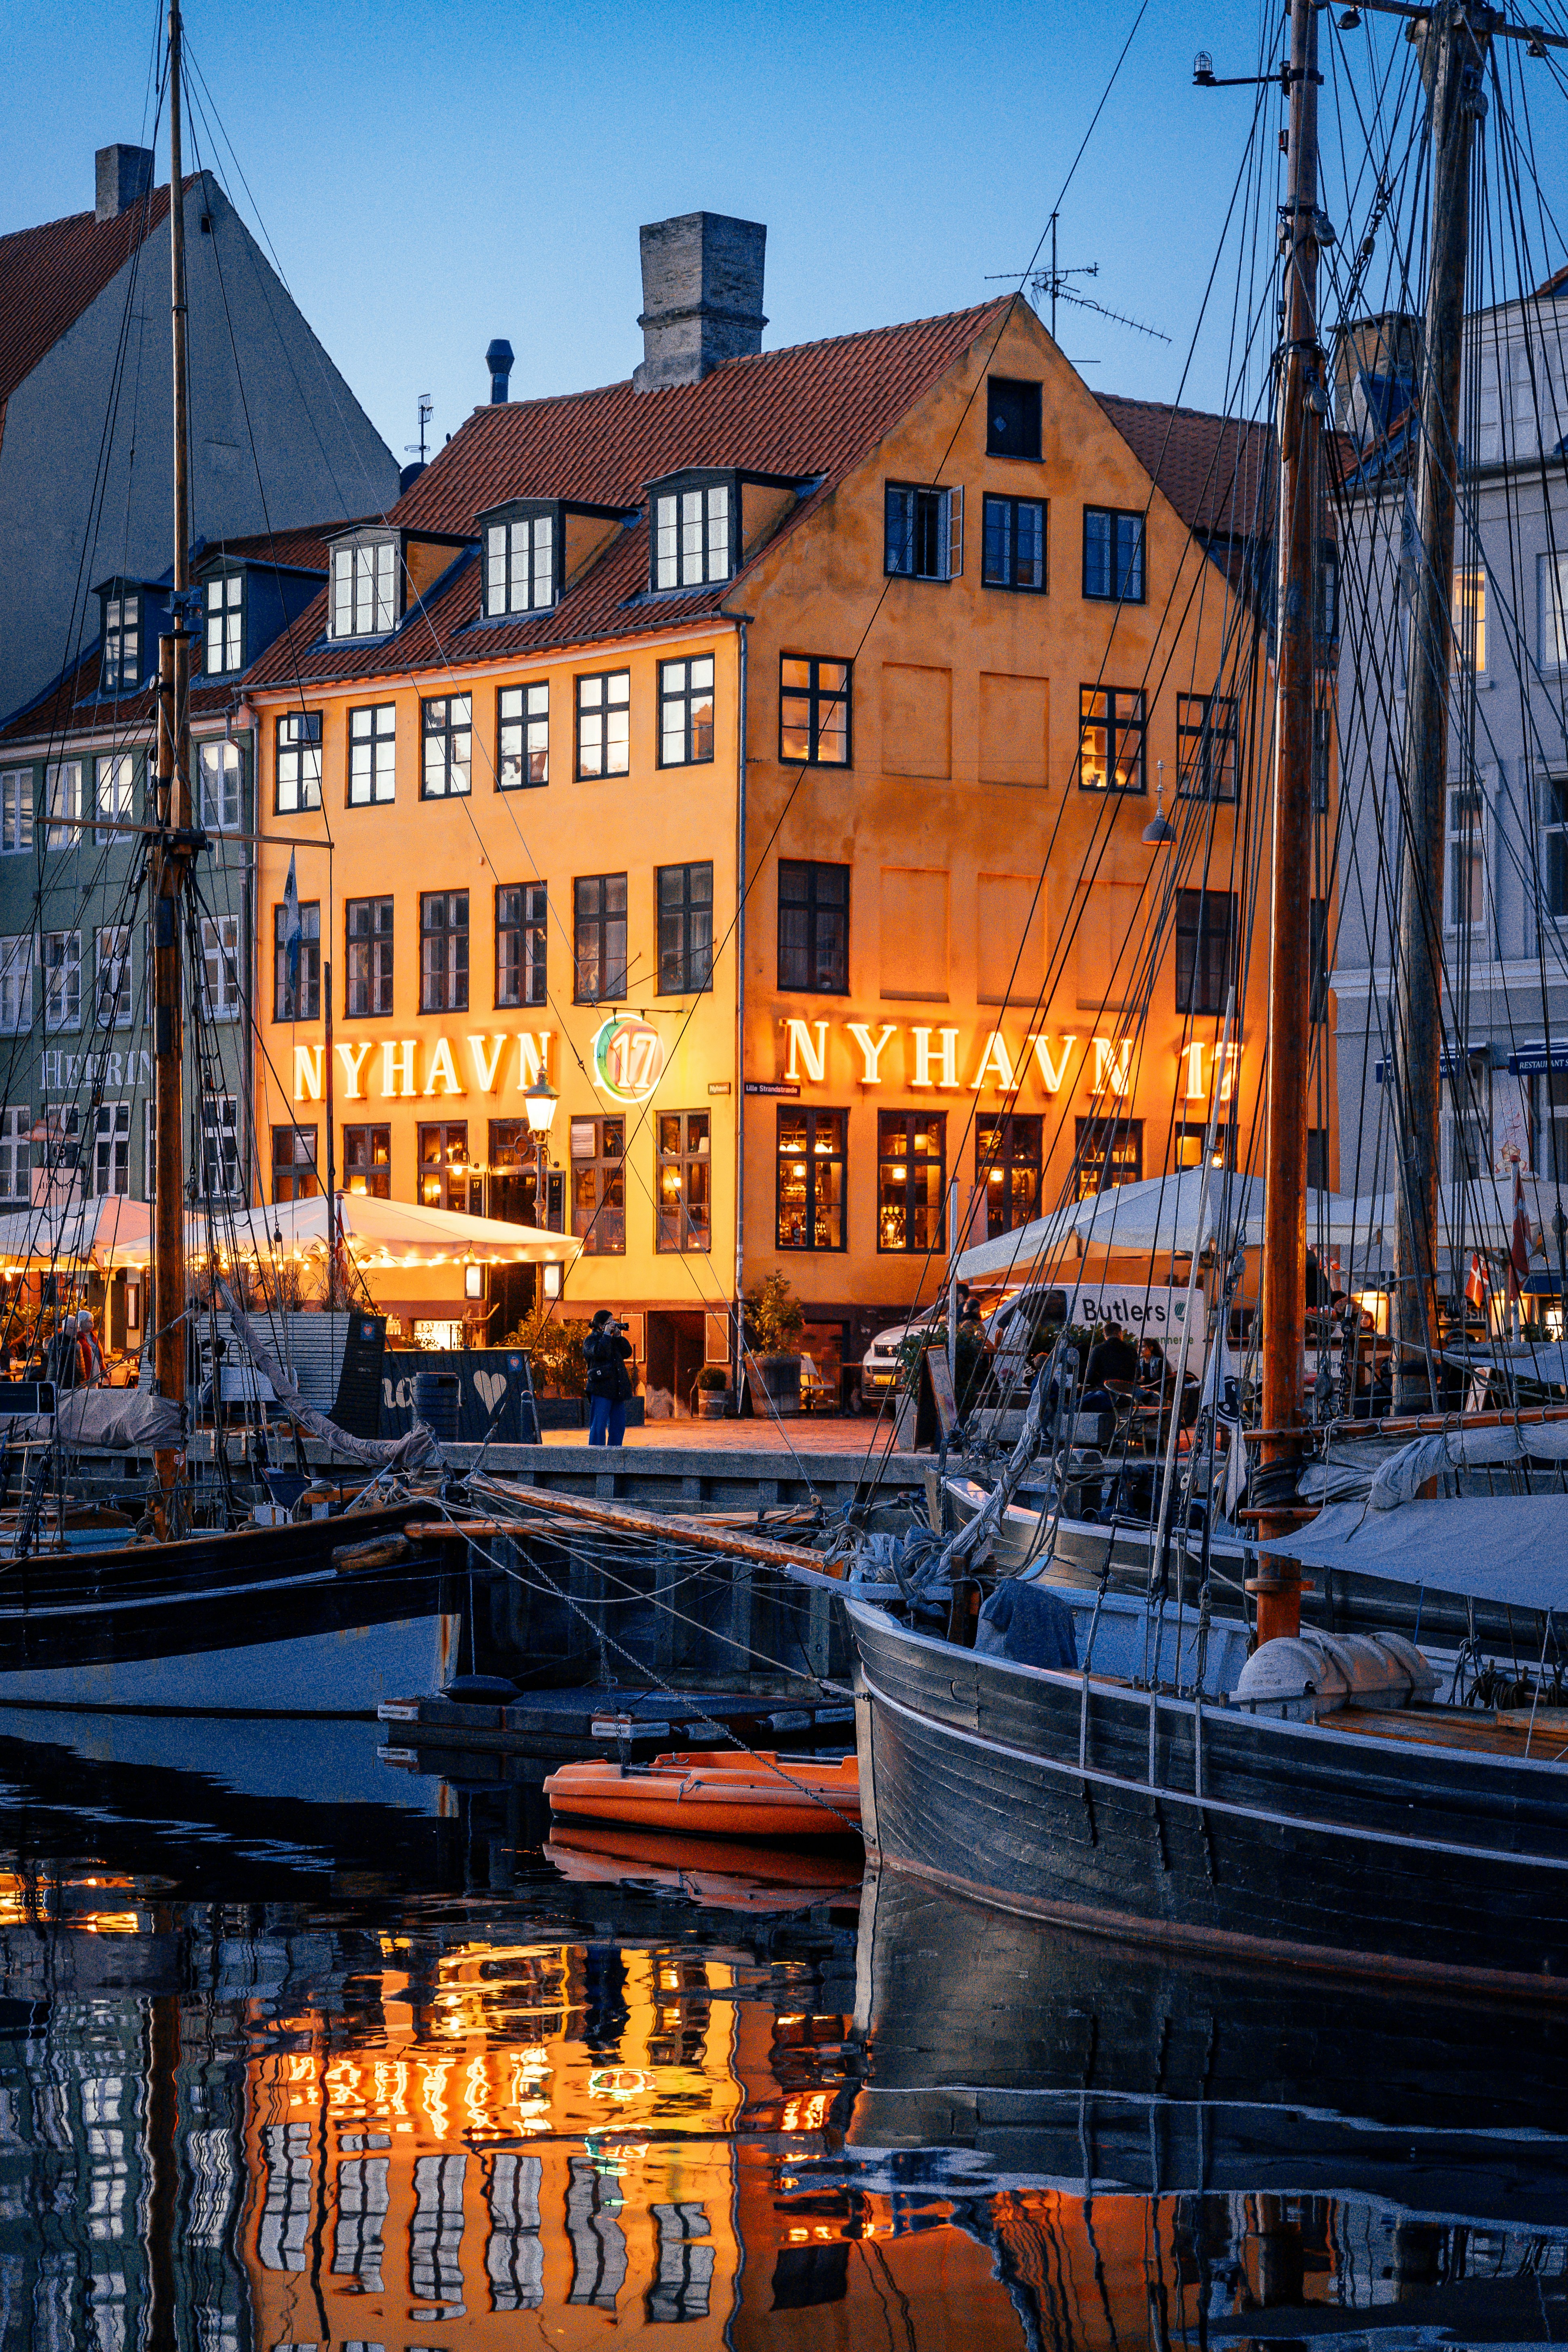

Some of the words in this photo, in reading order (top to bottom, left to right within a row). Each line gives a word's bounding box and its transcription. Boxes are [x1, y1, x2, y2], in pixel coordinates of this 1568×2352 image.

[39, 1050, 155, 1090] HERRIN
[293, 1031, 555, 1101] NYHAVN
[612, 1030, 658, 1088] 17
[779, 1018, 1133, 1096] NYHAVN
[709, 1085, 728, 1093] Nyhavn
[759, 1085, 798, 1094] Strandstræde
[1082, 1298, 1166, 1322] Butlers
